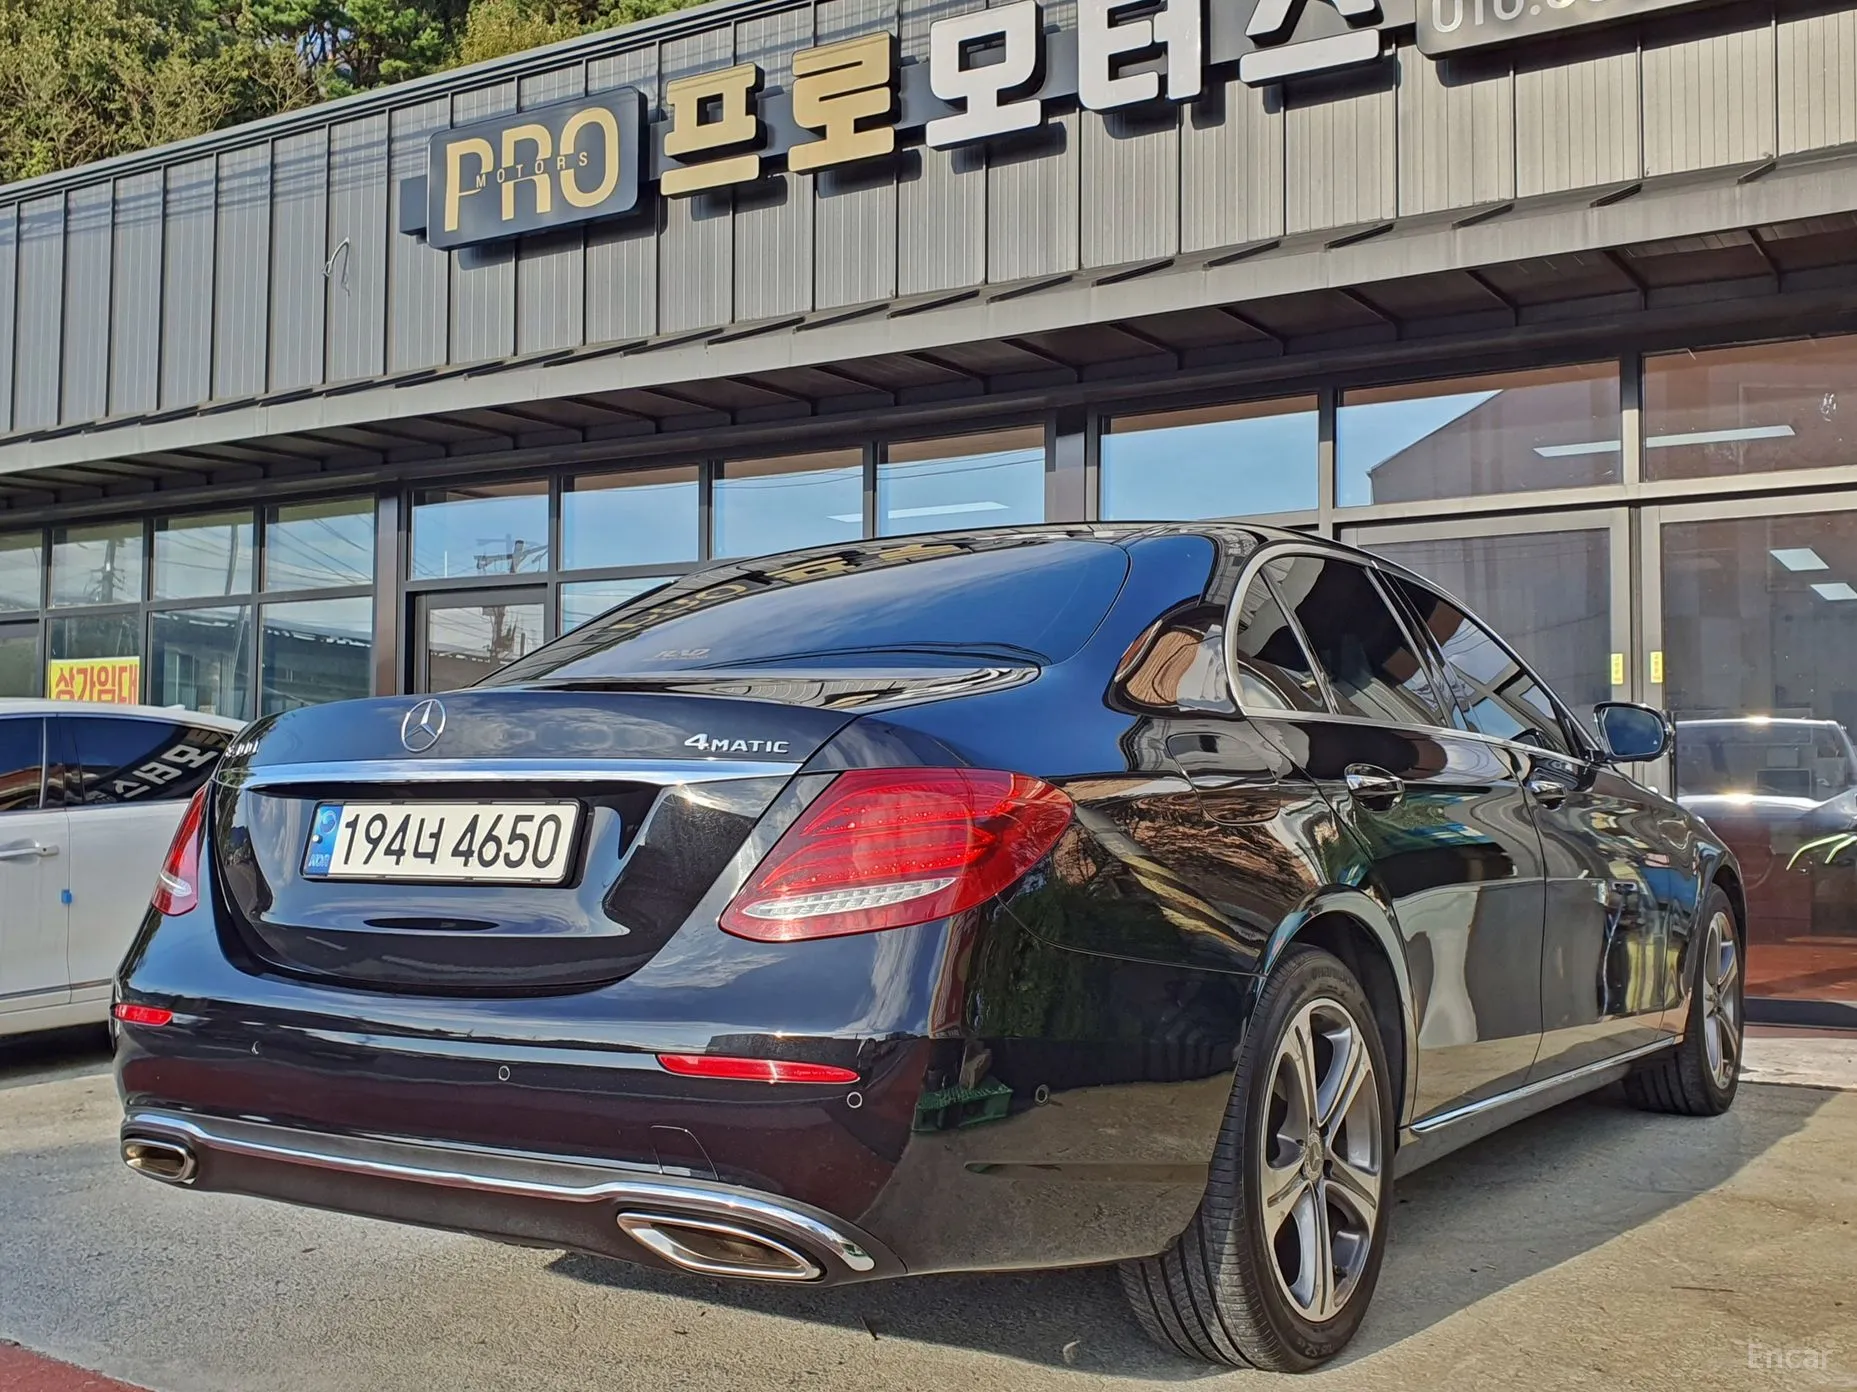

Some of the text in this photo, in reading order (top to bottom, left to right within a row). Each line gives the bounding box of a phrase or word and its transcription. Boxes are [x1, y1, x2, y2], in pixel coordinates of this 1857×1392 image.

[444, 107, 619, 232] PRO
[476, 152, 588, 188] MOTORS
[56, 665, 138, 704] 상가임대
[684, 733, 790, 753] 4MATIC
[344, 813, 562, 868] 194너 4650
